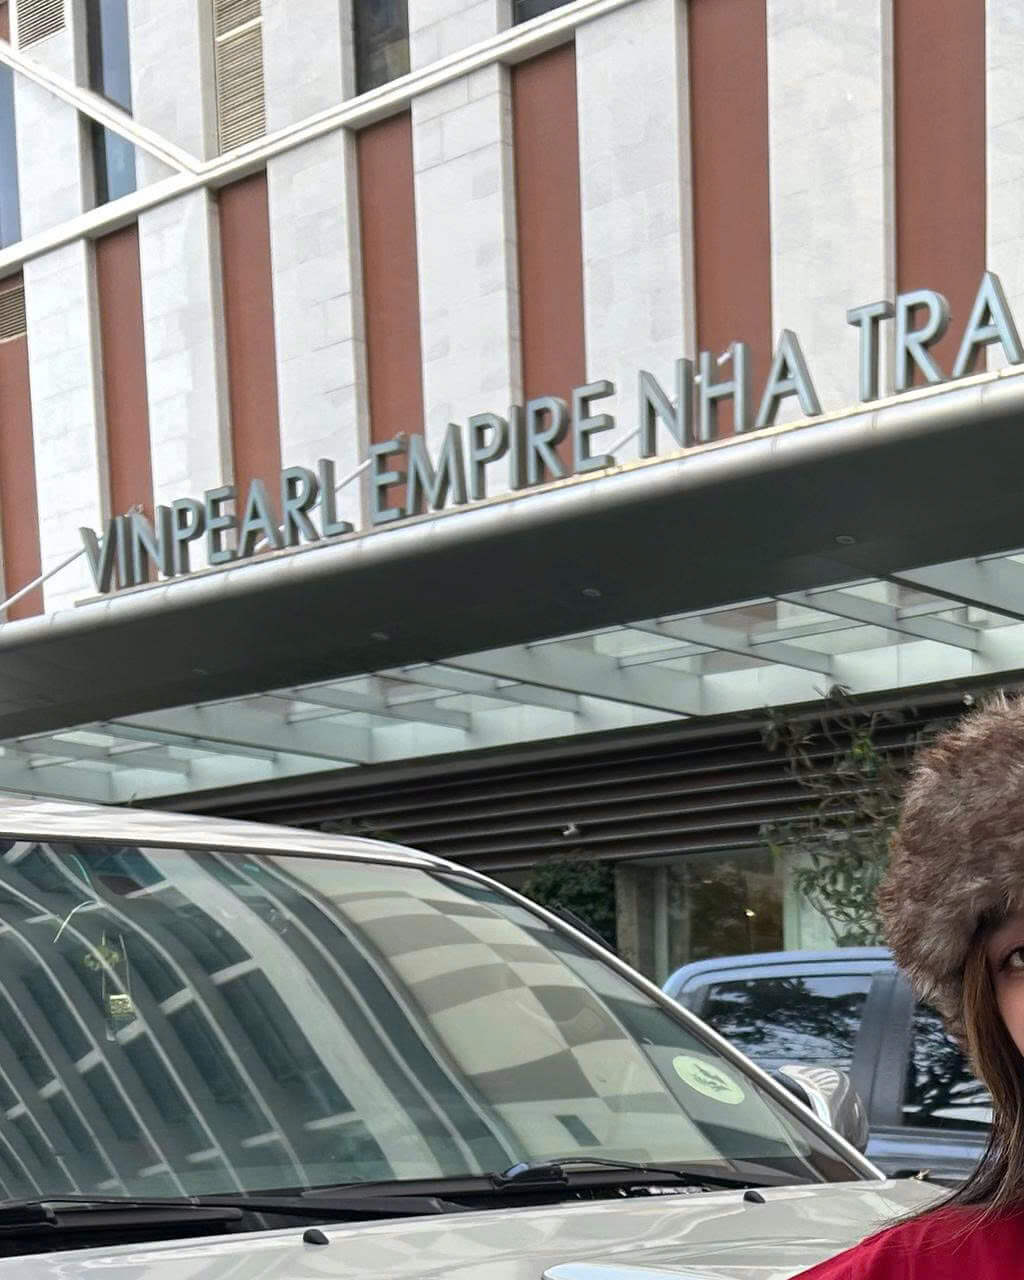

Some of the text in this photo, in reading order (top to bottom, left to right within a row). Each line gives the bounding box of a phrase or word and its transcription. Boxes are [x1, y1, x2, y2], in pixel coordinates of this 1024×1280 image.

[80, 458, 353, 593] VINPEARL
[369, 379, 615, 526] EMPIRE
[638, 328, 822, 458] NHA
